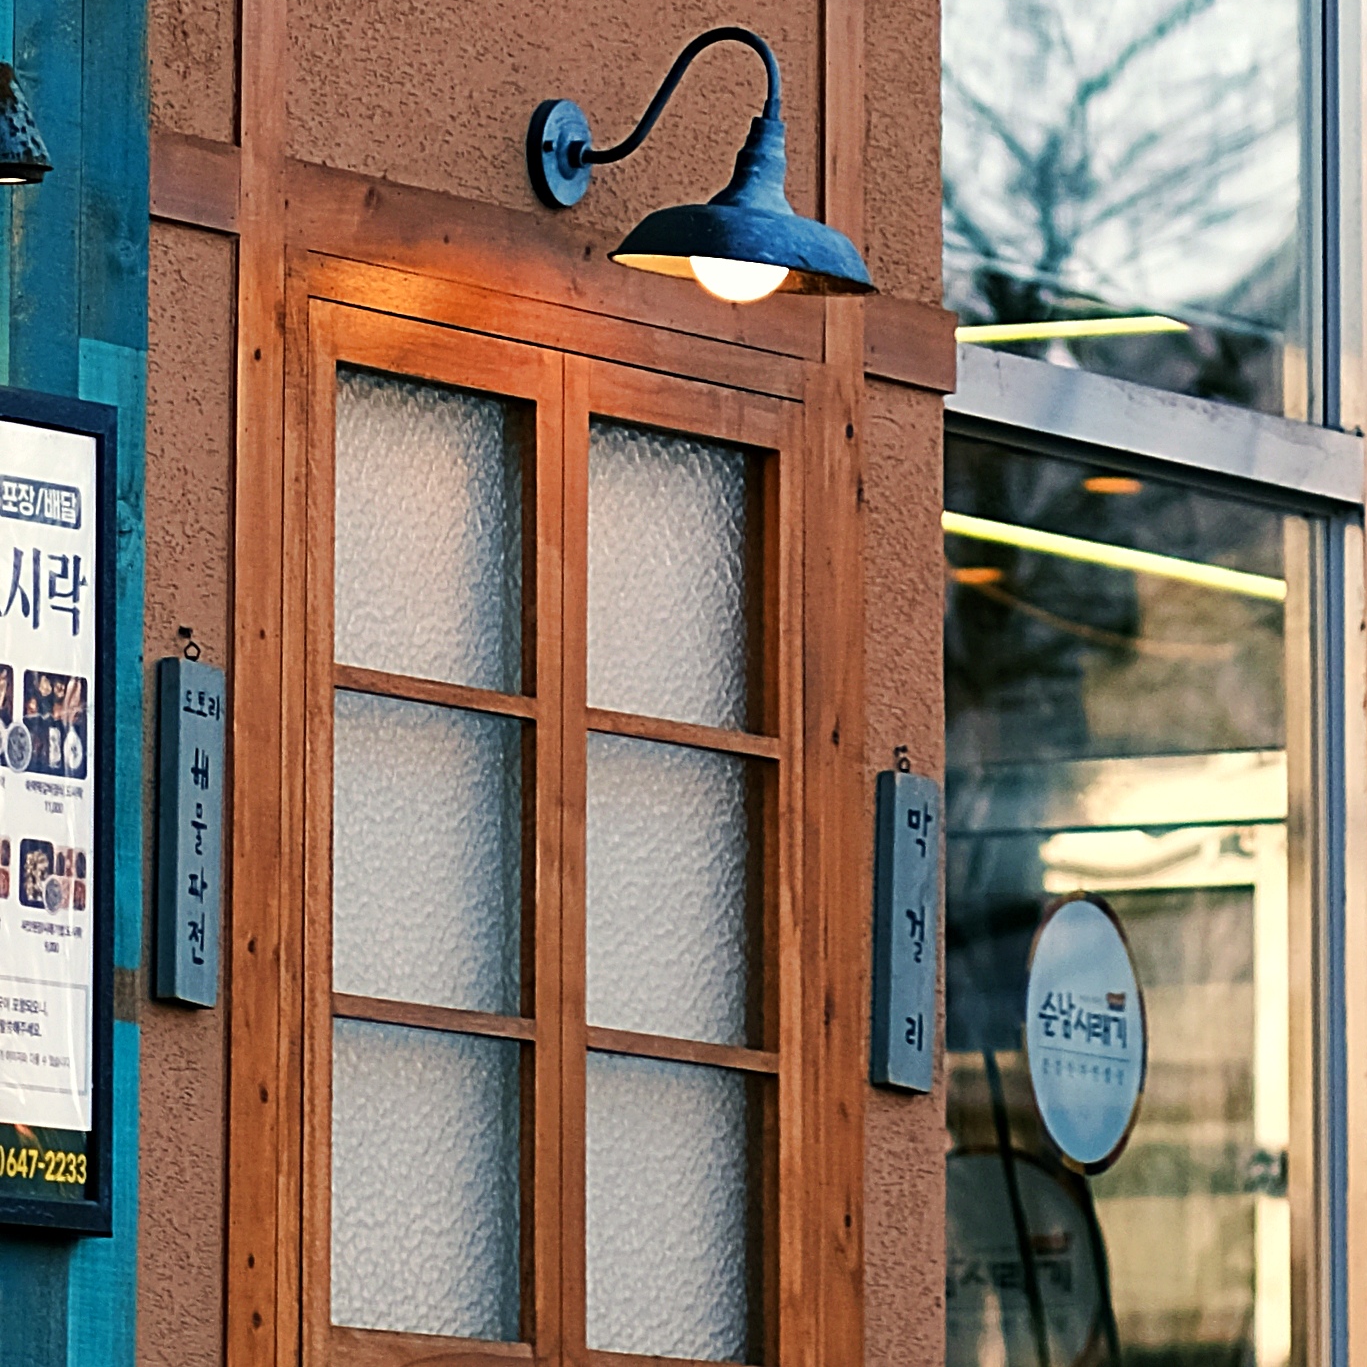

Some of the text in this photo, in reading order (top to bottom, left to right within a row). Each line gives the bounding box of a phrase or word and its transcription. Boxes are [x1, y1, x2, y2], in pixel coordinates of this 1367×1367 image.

[1, 480, 77, 524] 포장/배달
[0, 547, 88, 637] 시락
[183, 689, 221, 721] 도토리
[187, 746, 210, 967] 해물파전
[905, 801, 933, 1052] 막걸리
